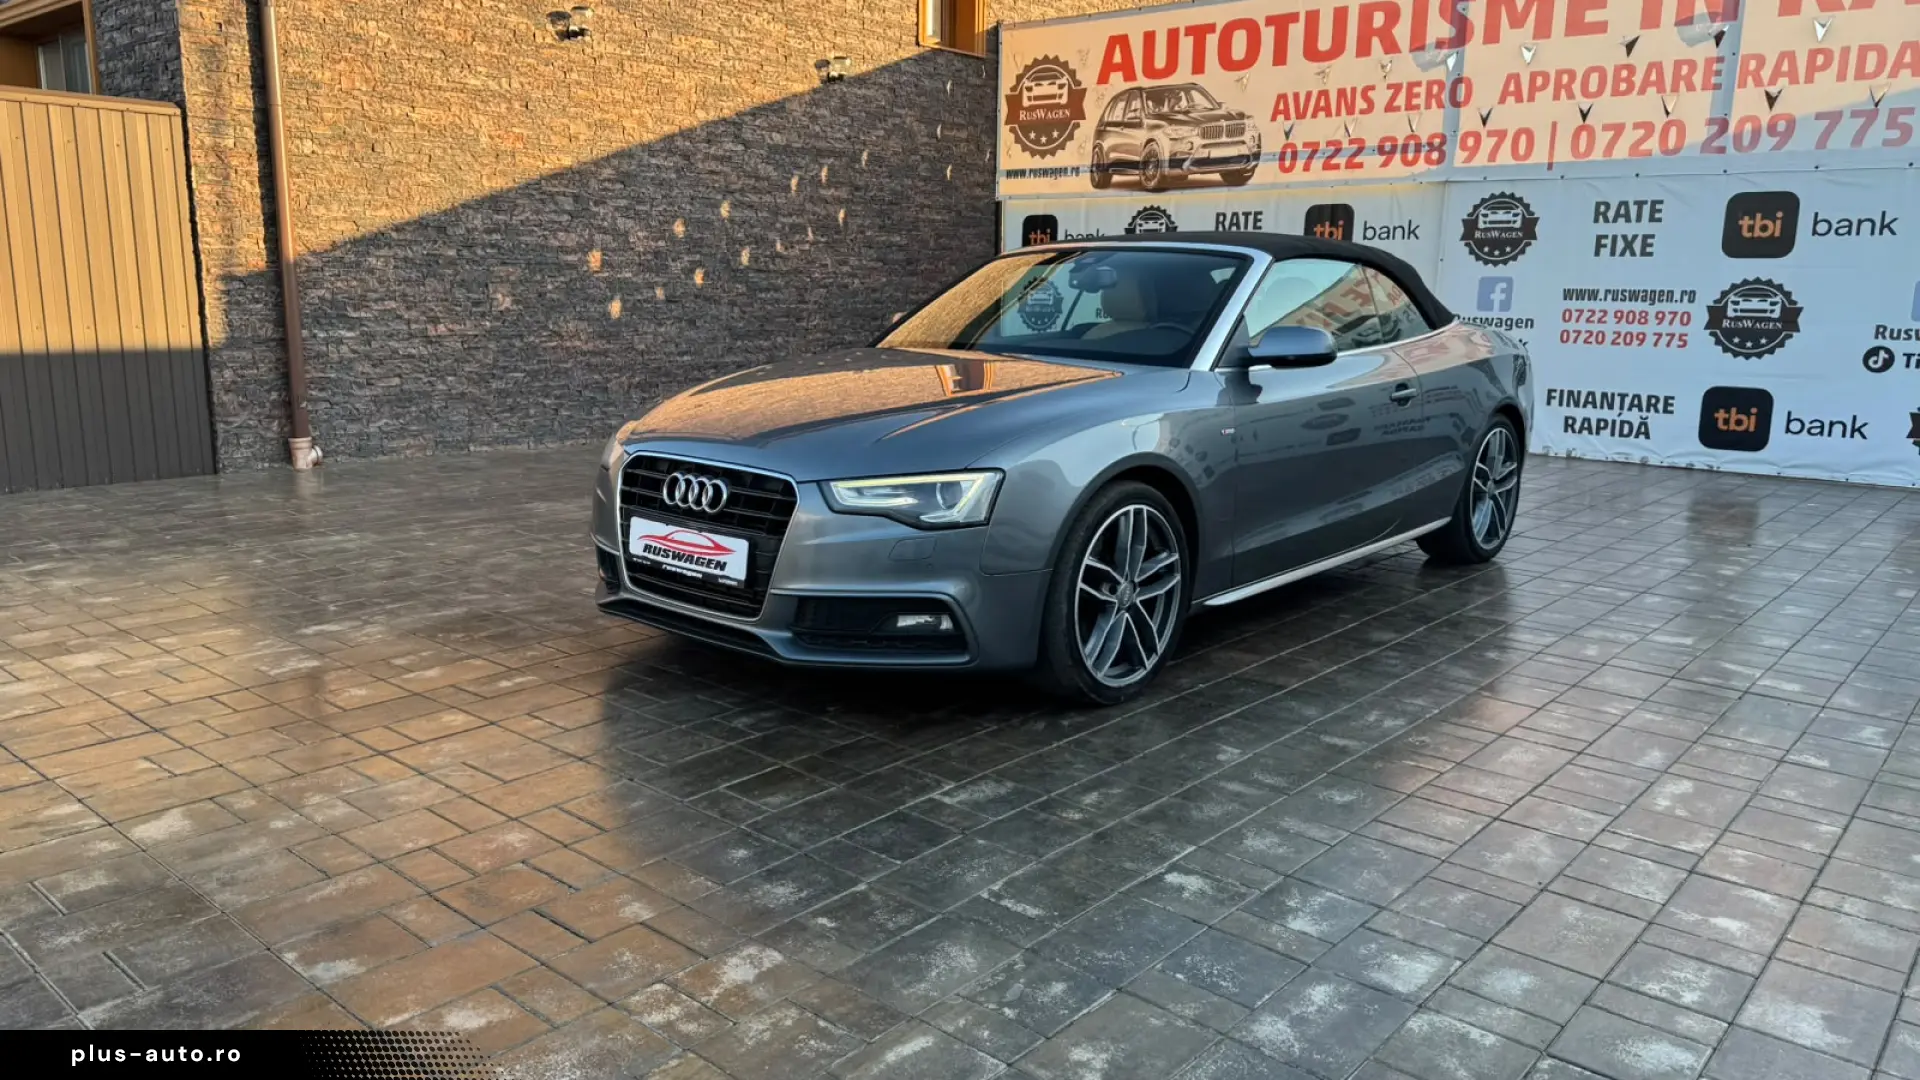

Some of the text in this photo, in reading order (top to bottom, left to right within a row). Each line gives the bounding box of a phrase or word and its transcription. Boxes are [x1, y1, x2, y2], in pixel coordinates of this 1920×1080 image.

[1270, 40, 1920, 122] AVANS ZERO APROBARE RAPIDA
[1278, 137, 1366, 173] 0722
[1378, 132, 1447, 169] 908
[1458, 127, 1535, 164] 970
[1570, 118, 1686, 160] 0720
[1701, 113, 1796, 155] 209
[1813, 107, 1916, 149] 775
[1215, 211, 1263, 231] RATE
[1593, 199, 1664, 224] RATE
[1314, 219, 1421, 241] tbi bank
[1738, 211, 1899, 239] tbi bank
[1594, 233, 1656, 258] FIXE
[1562, 287, 1696, 306] www.ruswagen.ro
[1562, 308, 1692, 327] 0722 908 970
[1559, 329, 1689, 348] 0720 209 775
[1563, 414, 1651, 440] RAPIDĂ
[1714, 407, 1869, 440] tbi bank
[643, 544, 728, 571] RUSWAGEN
